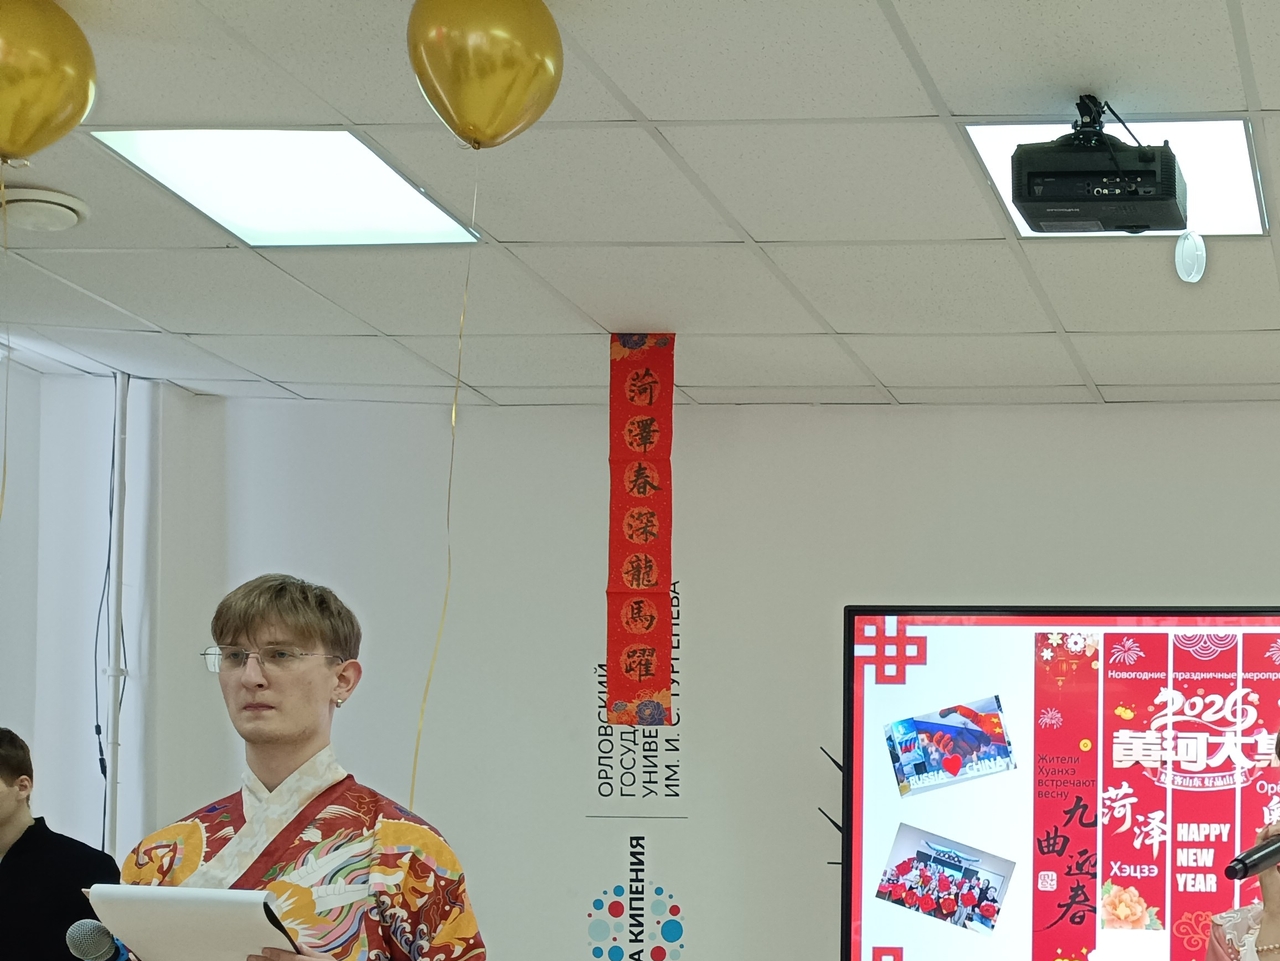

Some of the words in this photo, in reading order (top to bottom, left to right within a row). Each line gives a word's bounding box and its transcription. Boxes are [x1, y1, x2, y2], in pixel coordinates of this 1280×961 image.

[1107, 669, 1167, 681] Новогодние
[1172, 669, 1238, 682] праздничные
[1150, 686, 1259, 731] 2026
[664, 733, 680, 751] И.
[620, 725, 639, 798] ГОСУД
[642, 728, 659, 799] УНИВЕ
[1037, 753, 1081, 765] Жители
[664, 759, 680, 798] ИМ.
[908, 769, 947, 787] RUSSIA
[965, 756, 1007, 775] CHINA
[1037, 765, 1077, 777] Хуанхэ
[1037, 778, 1096, 790] встречают
[1037, 790, 1070, 800] весну
[1176, 823, 1230, 842] HAPPY
[1175, 848, 1215, 867] NEW
[1110, 861, 1159, 879] Хэцзэ
[628, 836, 646, 943] КИПЕНИЯ
[1175, 873, 1217, 893] YEAR
